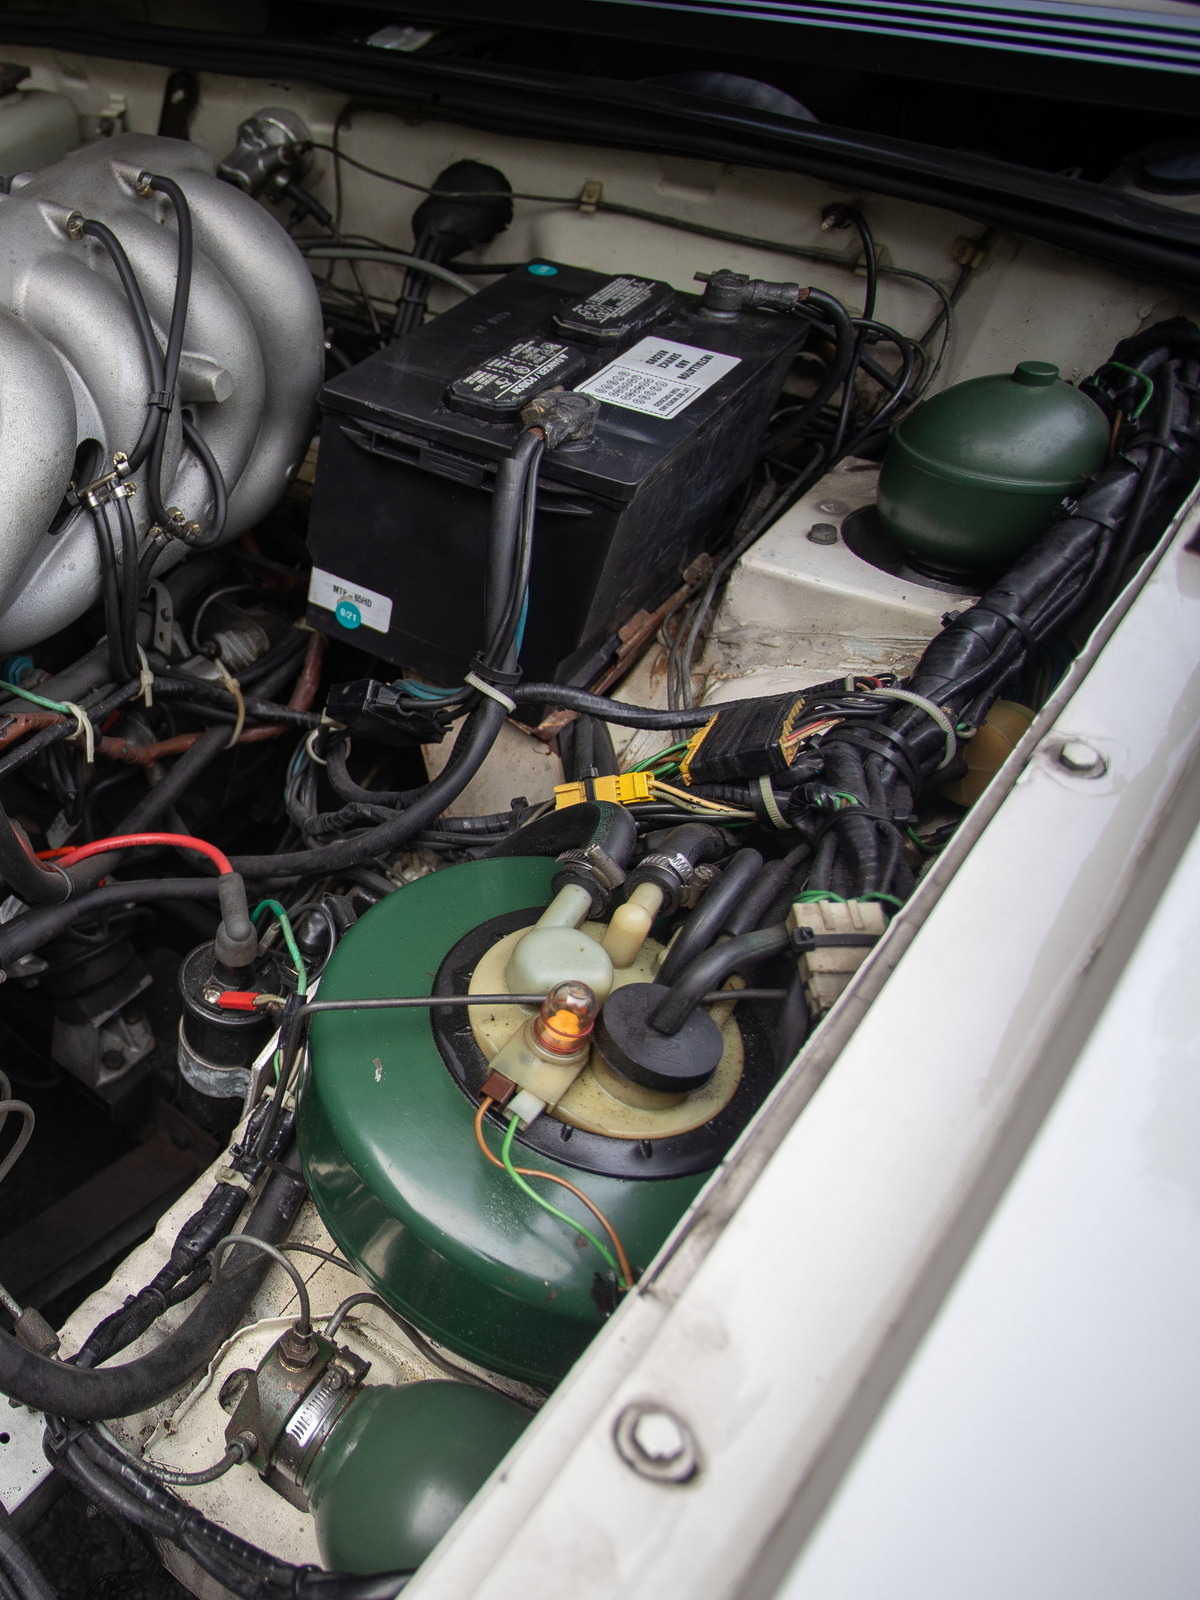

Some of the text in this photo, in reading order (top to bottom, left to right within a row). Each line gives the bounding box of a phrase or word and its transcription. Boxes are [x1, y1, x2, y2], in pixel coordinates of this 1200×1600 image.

[535, 357, 565, 376] DANGER
[656, 352, 683, 369] SERVICE
[676, 354, 714, 380] INSTALLATION
